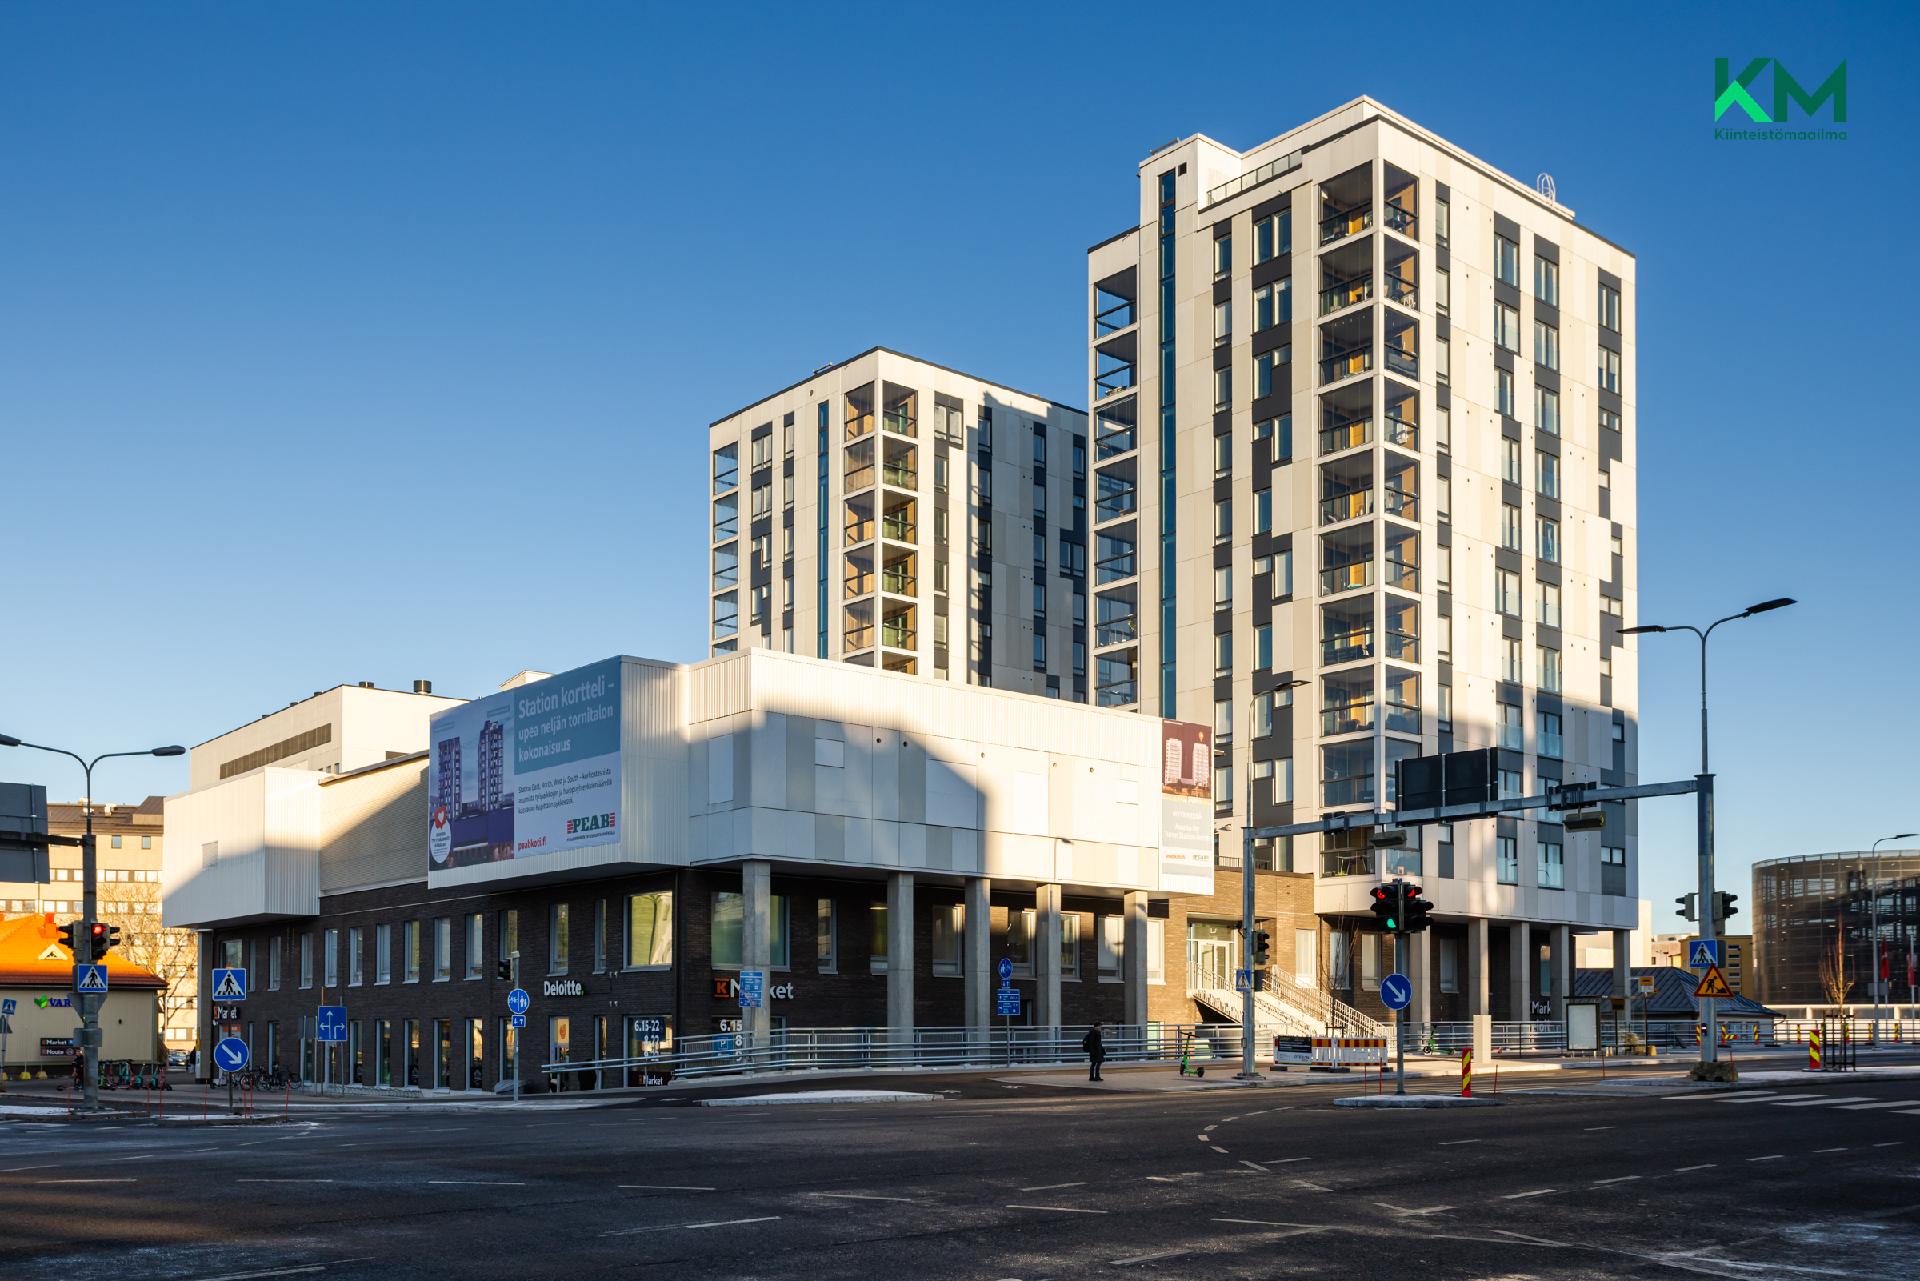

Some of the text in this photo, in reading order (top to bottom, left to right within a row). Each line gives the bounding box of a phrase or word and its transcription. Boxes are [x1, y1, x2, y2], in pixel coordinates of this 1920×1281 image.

[518, 692, 559, 719] Station
[561, 675, 605, 708] kortteli
[518, 704, 614, 743] upea neljän tornitalon
[518, 739, 571, 762] kokonaisuus
[572, 813, 611, 834] PEAB
